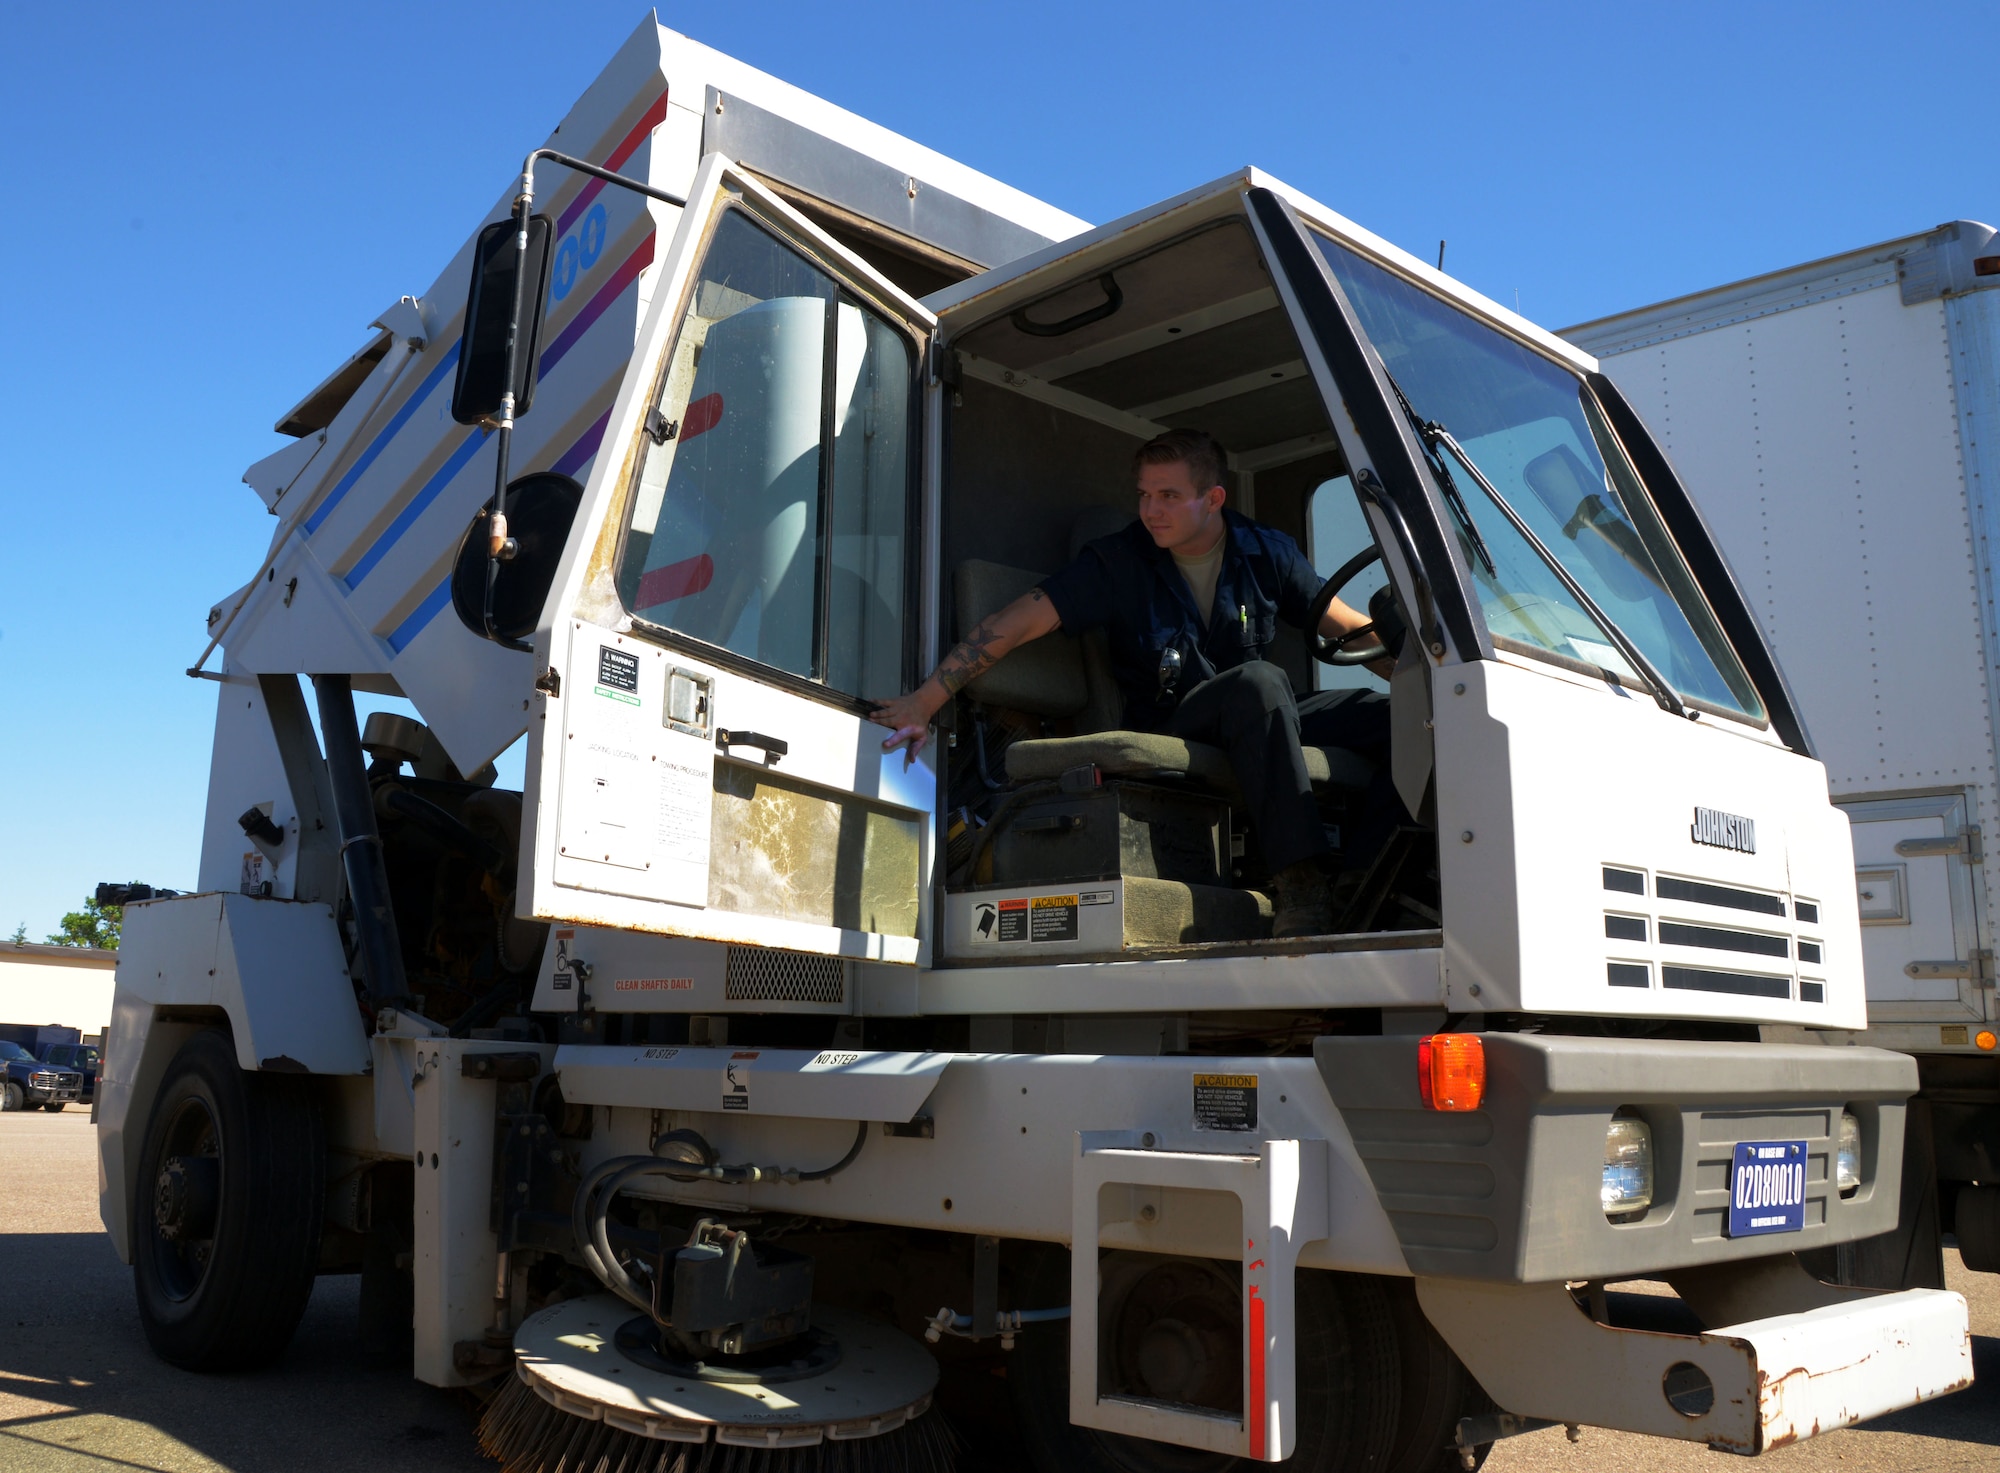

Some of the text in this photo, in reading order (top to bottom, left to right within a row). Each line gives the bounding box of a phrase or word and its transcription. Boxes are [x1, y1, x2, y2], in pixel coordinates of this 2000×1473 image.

[546, 203, 607, 312] 00
[611, 653, 634, 667] WARNING
[613, 750, 639, 761] LOCATION
[660, 760, 708, 779] TOWING PROCEDURE
[1691, 806, 1757, 855] JOHNSTON
[1042, 897, 1074, 906] CAUTION
[616, 979, 693, 990] CLEAN SHAFTS DAILY
[643, 1049, 679, 1059] NO STEP
[814, 1054, 858, 1065] NO STEP
[1208, 1077, 1252, 1087] CAUTION
[1764, 1147, 1776, 1159] BASE
[1736, 1163, 1803, 1209] 02D80010
